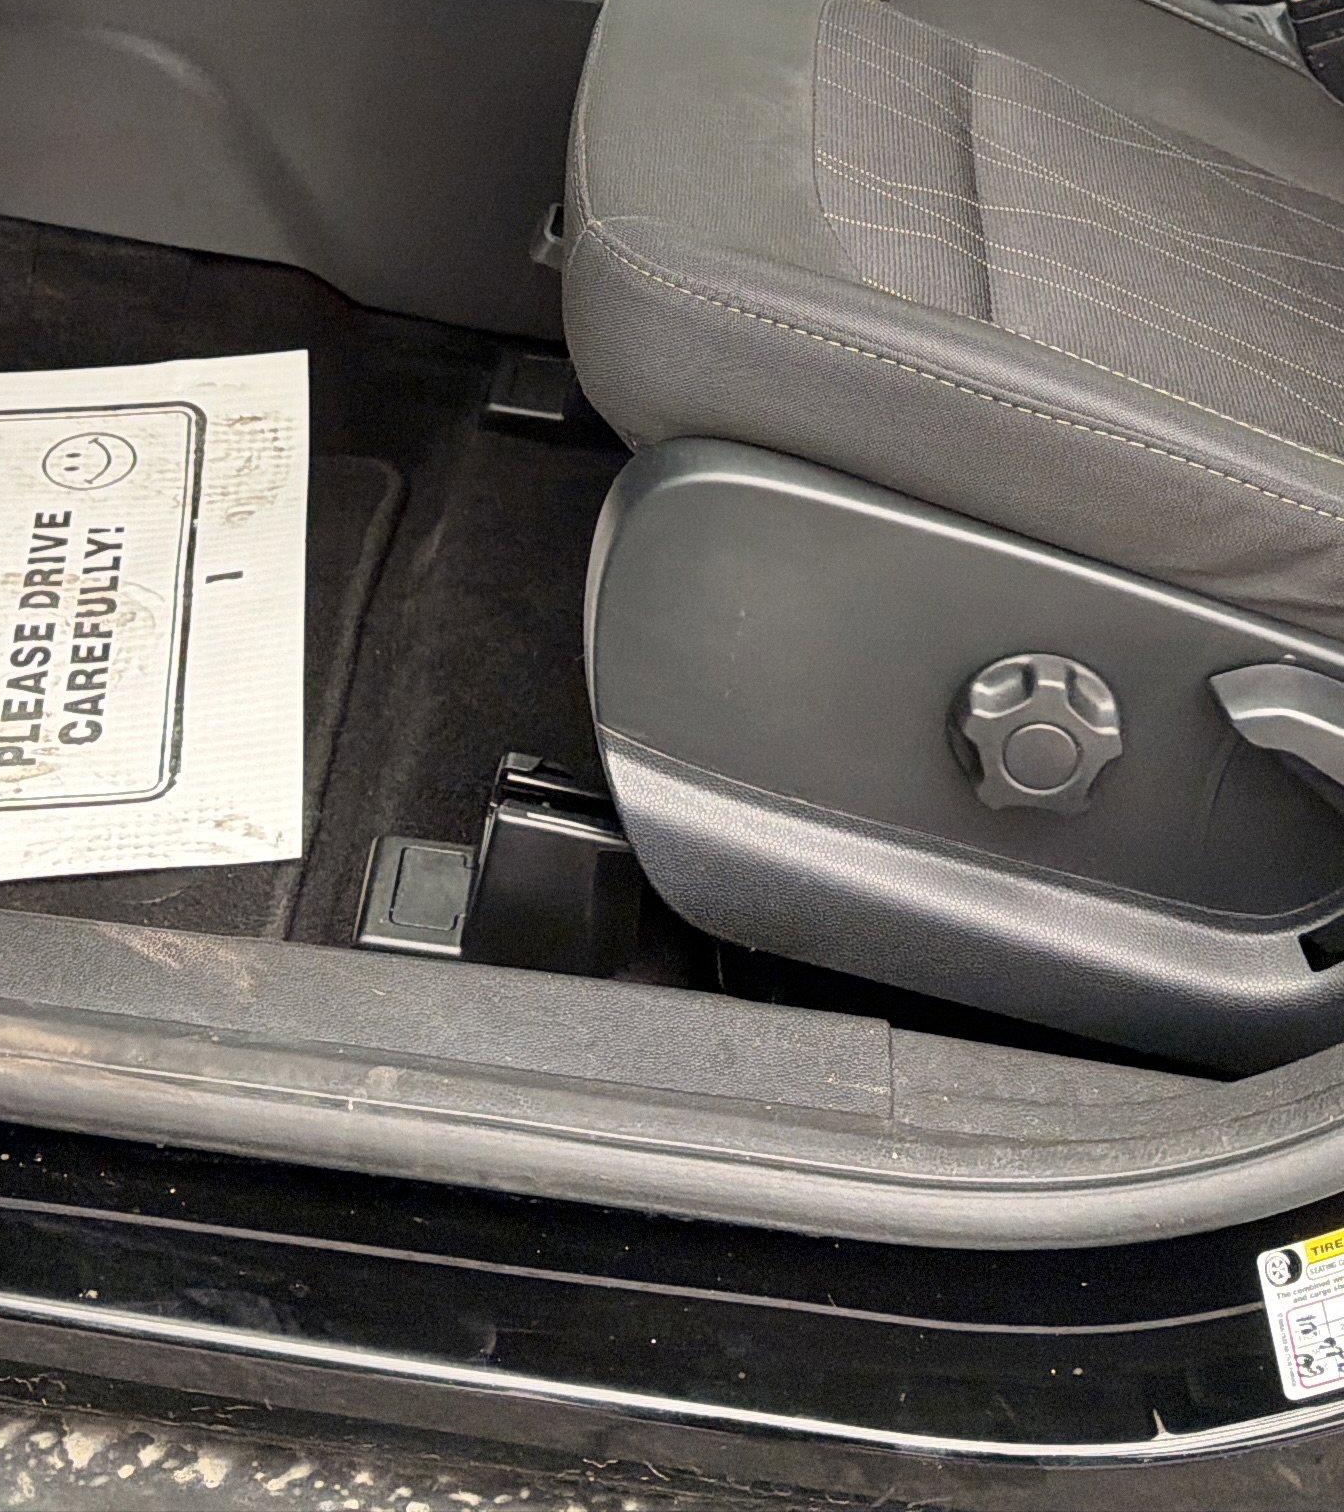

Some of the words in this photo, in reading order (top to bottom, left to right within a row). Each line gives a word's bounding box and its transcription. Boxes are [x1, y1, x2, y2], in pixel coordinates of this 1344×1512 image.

[18, 510, 73, 610] DRIVE
[57, 526, 126, 746] CAREFULLY!
[1310, 1240, 1344, 1256] TIRE
[1310, 1262, 1337, 1275] SEATING
[1293, 1279, 1330, 1295] combined
[1293, 1294, 1307, 1303] and
[1310, 1288, 1331, 1298] cargo
